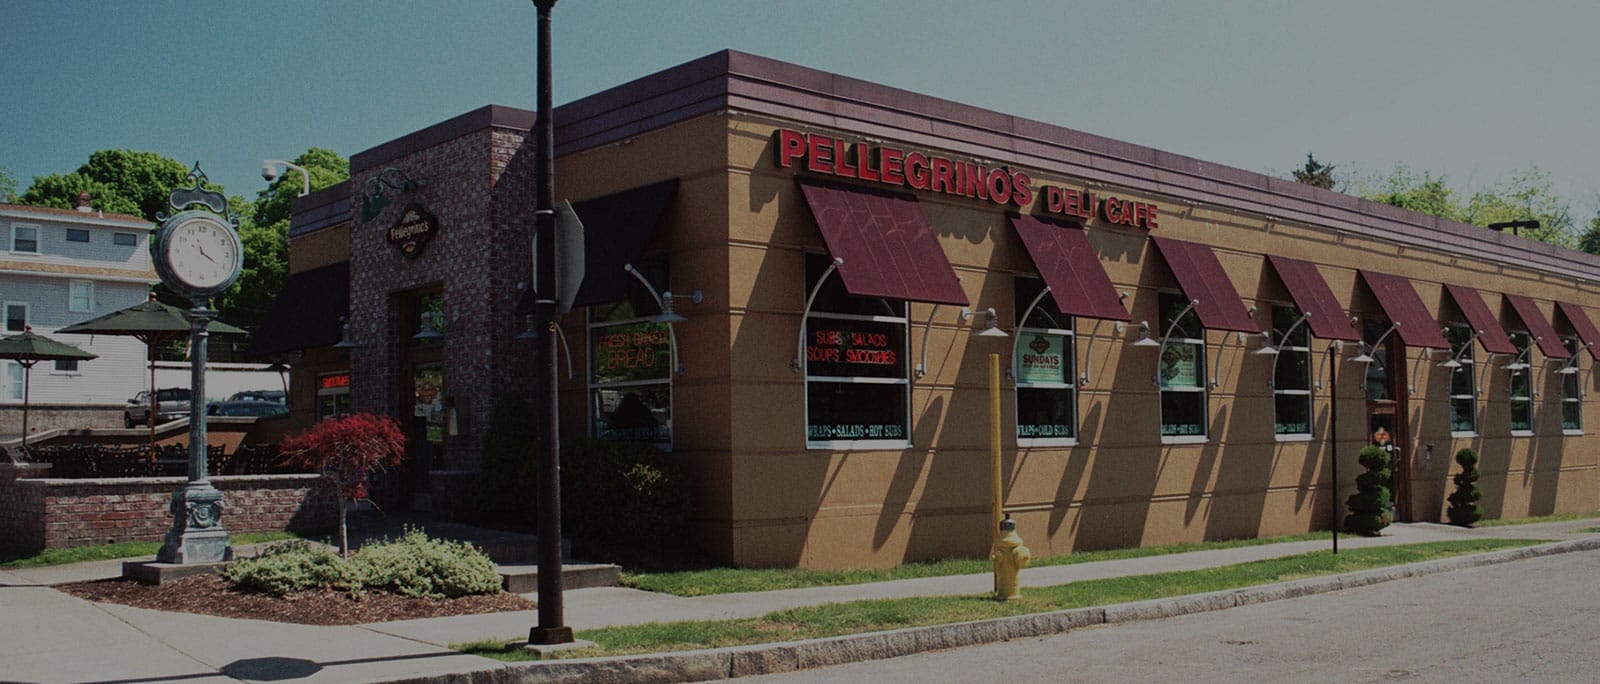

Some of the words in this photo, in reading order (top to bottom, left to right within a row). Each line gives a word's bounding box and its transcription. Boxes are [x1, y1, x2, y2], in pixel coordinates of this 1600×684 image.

[778, 129, 1033, 207] PELLEGRINO'S
[1047, 185, 1097, 219] DELI
[1105, 196, 1159, 229] CAFE
[816, 330, 842, 345] SUBS
[850, 332, 887, 347] SALADS
[607, 348, 656, 369] BREAD
[807, 346, 840, 362] SOUPS
[845, 349, 896, 365] SMOOTHIES
[1023, 354, 1060, 366] SUNDAYS
[836, 424, 865, 437] SALADS
[869, 425, 882, 437] HOT
[884, 425, 903, 437] SUBS
